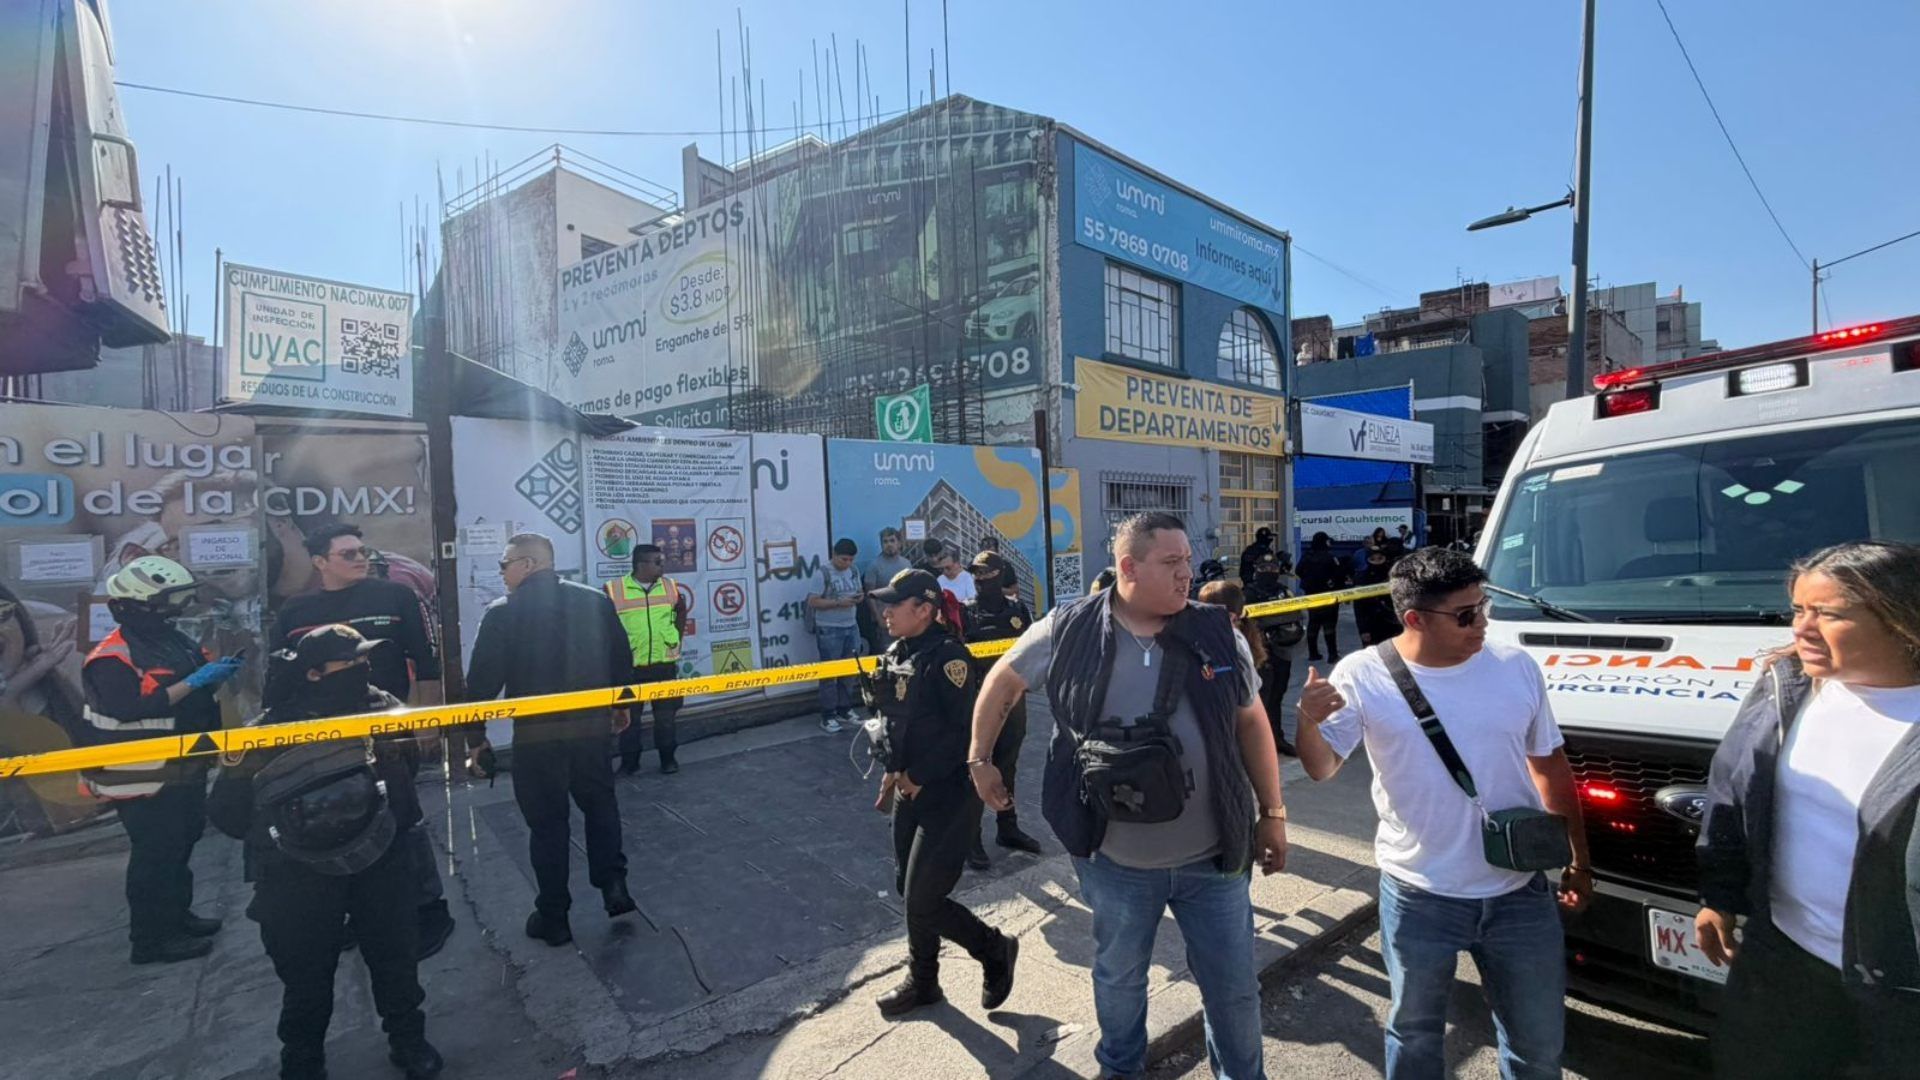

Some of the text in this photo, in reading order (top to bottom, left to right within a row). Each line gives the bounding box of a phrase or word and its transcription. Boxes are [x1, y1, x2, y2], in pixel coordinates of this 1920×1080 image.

[1116, 179, 1165, 216] ummi
[562, 201, 744, 291] PREVENTA DEPTOS
[1084, 216, 1189, 272] 55 7969 0708
[1210, 216, 1280, 258] ummiroma.mx
[680, 266, 724, 292] Desde:
[1195, 237, 1272, 286] Informes aquí
[229, 270, 407, 311] CUMPLIMIENTO NACDMX 007
[669, 289, 703, 316] $3.8
[256, 303, 315, 320] UNIDAD DE
[592, 310, 648, 350] ummi
[655, 328, 710, 352] Enganche
[249, 332, 321, 365] UVAC
[241, 381, 289, 396] RESIDUOS
[293, 386, 306, 398] DE
[308, 386, 320, 399] LA
[615, 388, 632, 406] de
[635, 382, 673, 408] pago
[677, 364, 749, 394] flexibles
[1126, 376, 1252, 418] PREVENTA DE
[655, 404, 712, 427] Solicita
[1100, 404, 1271, 448] DEPARTAMENTOS
[44, 431, 100, 466] el
[125, 432, 282, 478] lugar
[873, 450, 935, 471] ummi
[0, 480, 416, 516] ol de la CDMX!
[201, 537, 239, 545] INGRESO
[215, 545, 226, 553] DE
